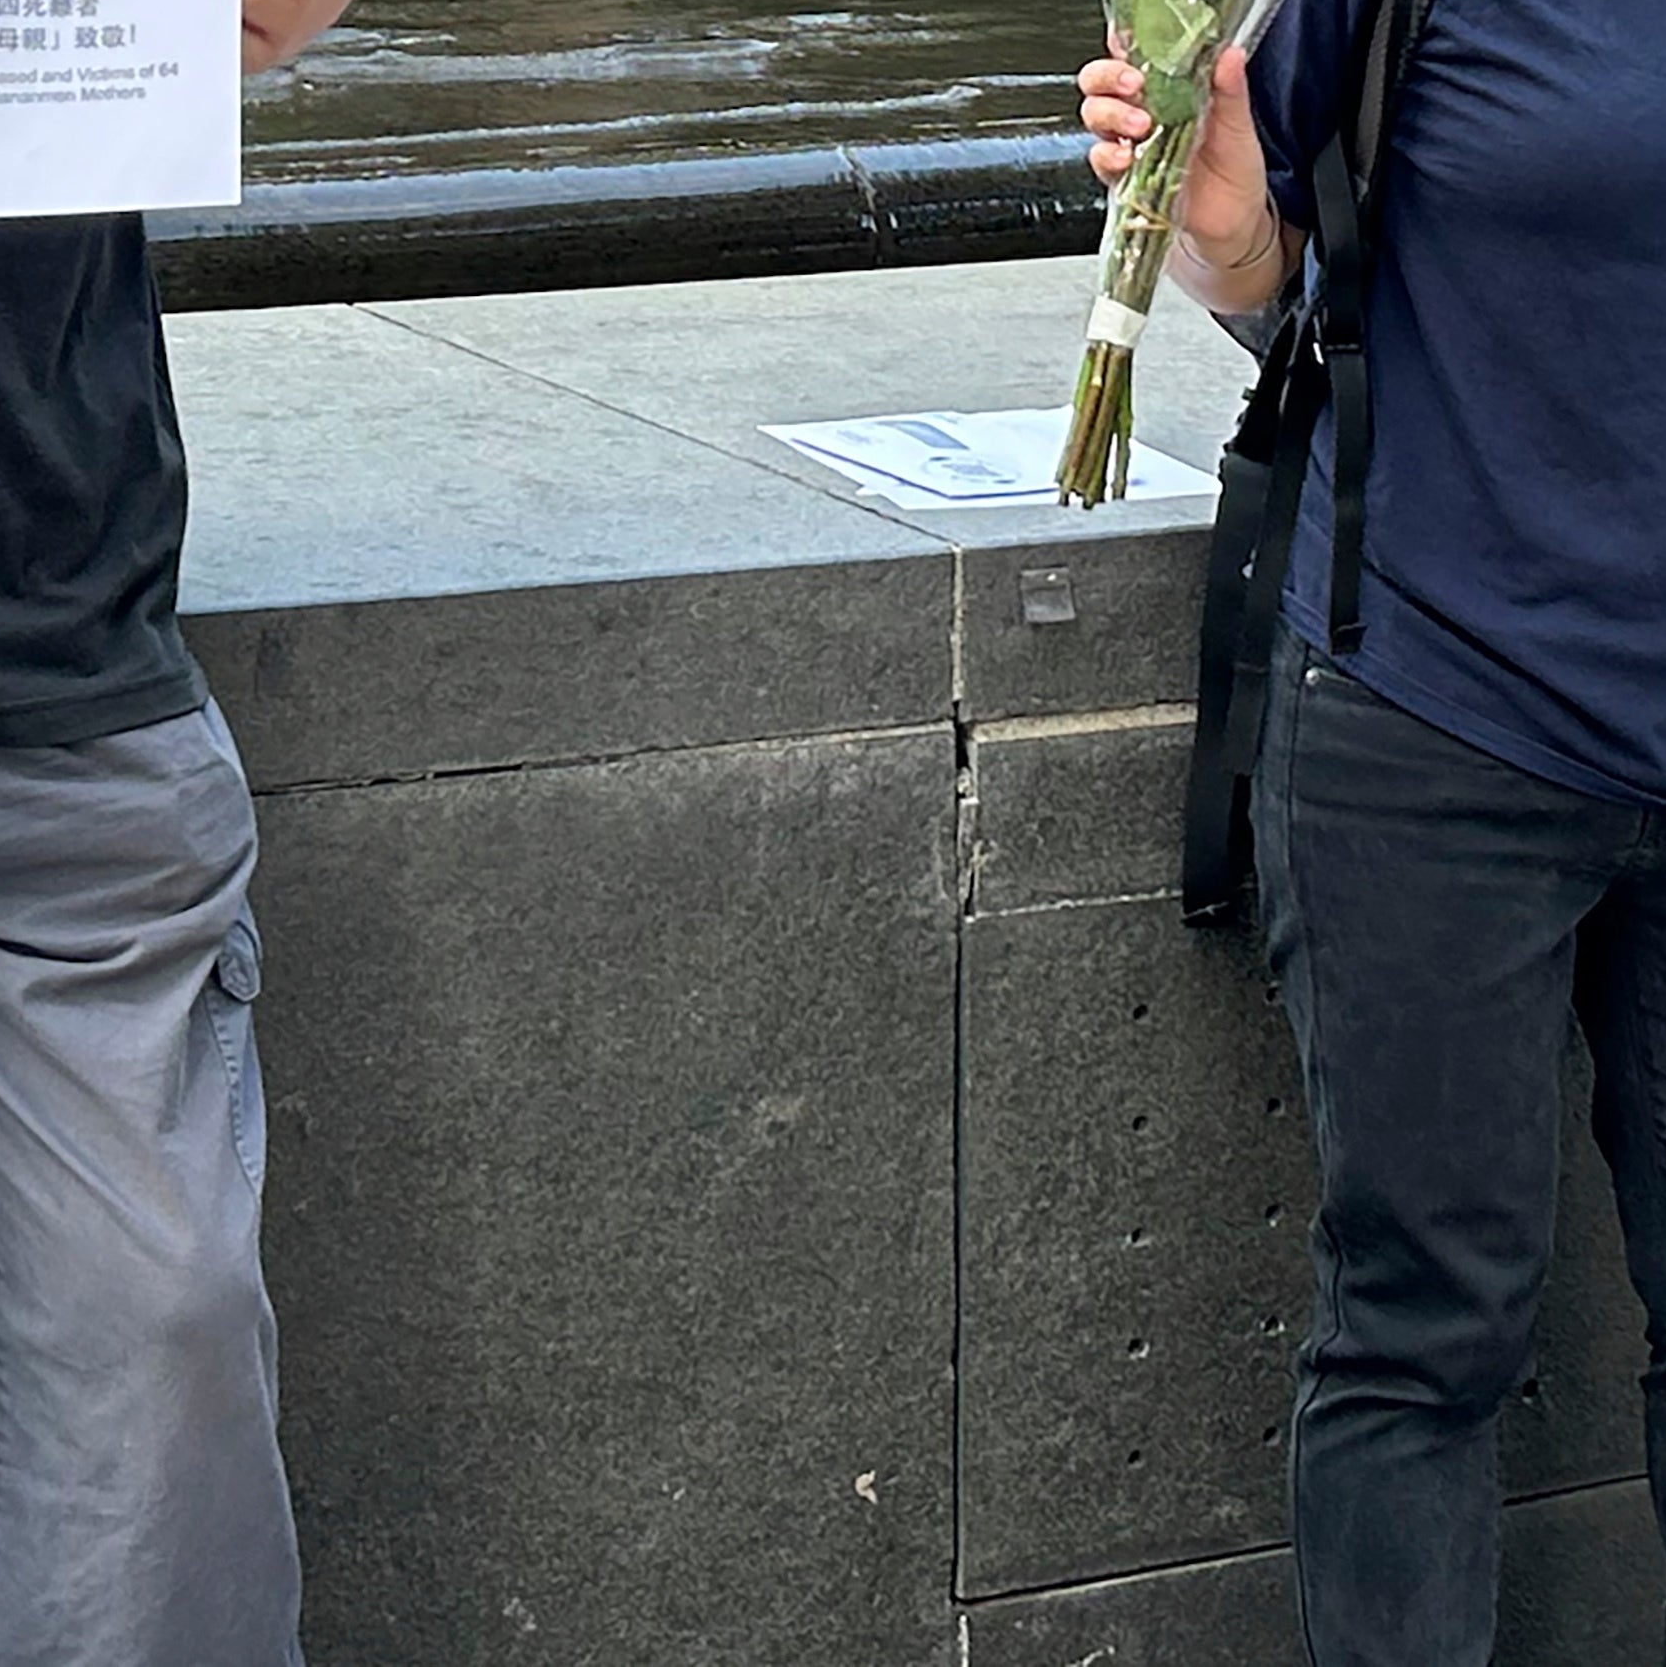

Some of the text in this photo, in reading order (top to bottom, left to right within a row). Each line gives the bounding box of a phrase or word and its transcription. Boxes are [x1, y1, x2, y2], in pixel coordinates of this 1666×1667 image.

[42, 67, 72, 83] and
[77, 65, 135, 82] Victims
[140, 64, 155, 79] of
[159, 62, 178, 77] 64
[81, 86, 146, 102] Mothers
